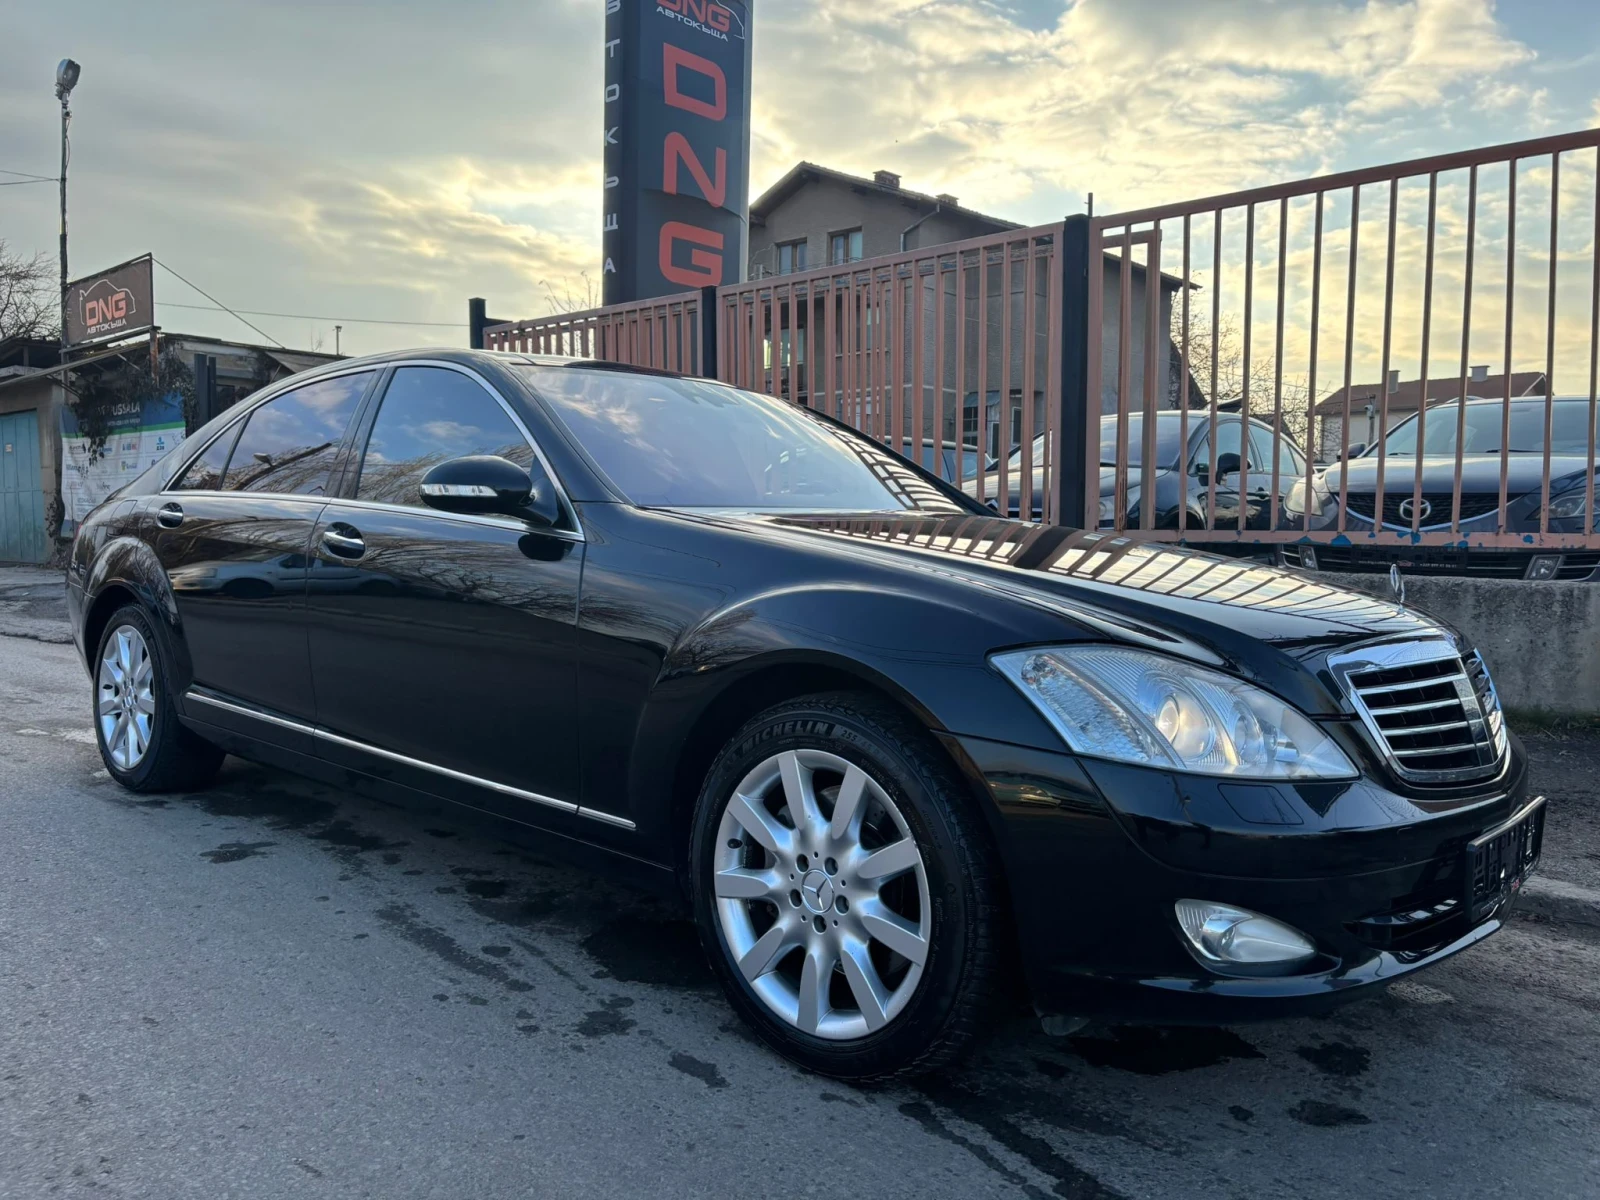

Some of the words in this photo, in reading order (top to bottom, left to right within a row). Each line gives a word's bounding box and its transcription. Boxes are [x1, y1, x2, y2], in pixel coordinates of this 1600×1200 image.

[659, 42, 727, 288] DNG
[86, 291, 126, 326] DNG
[742, 720, 829, 754] MICHELIN
